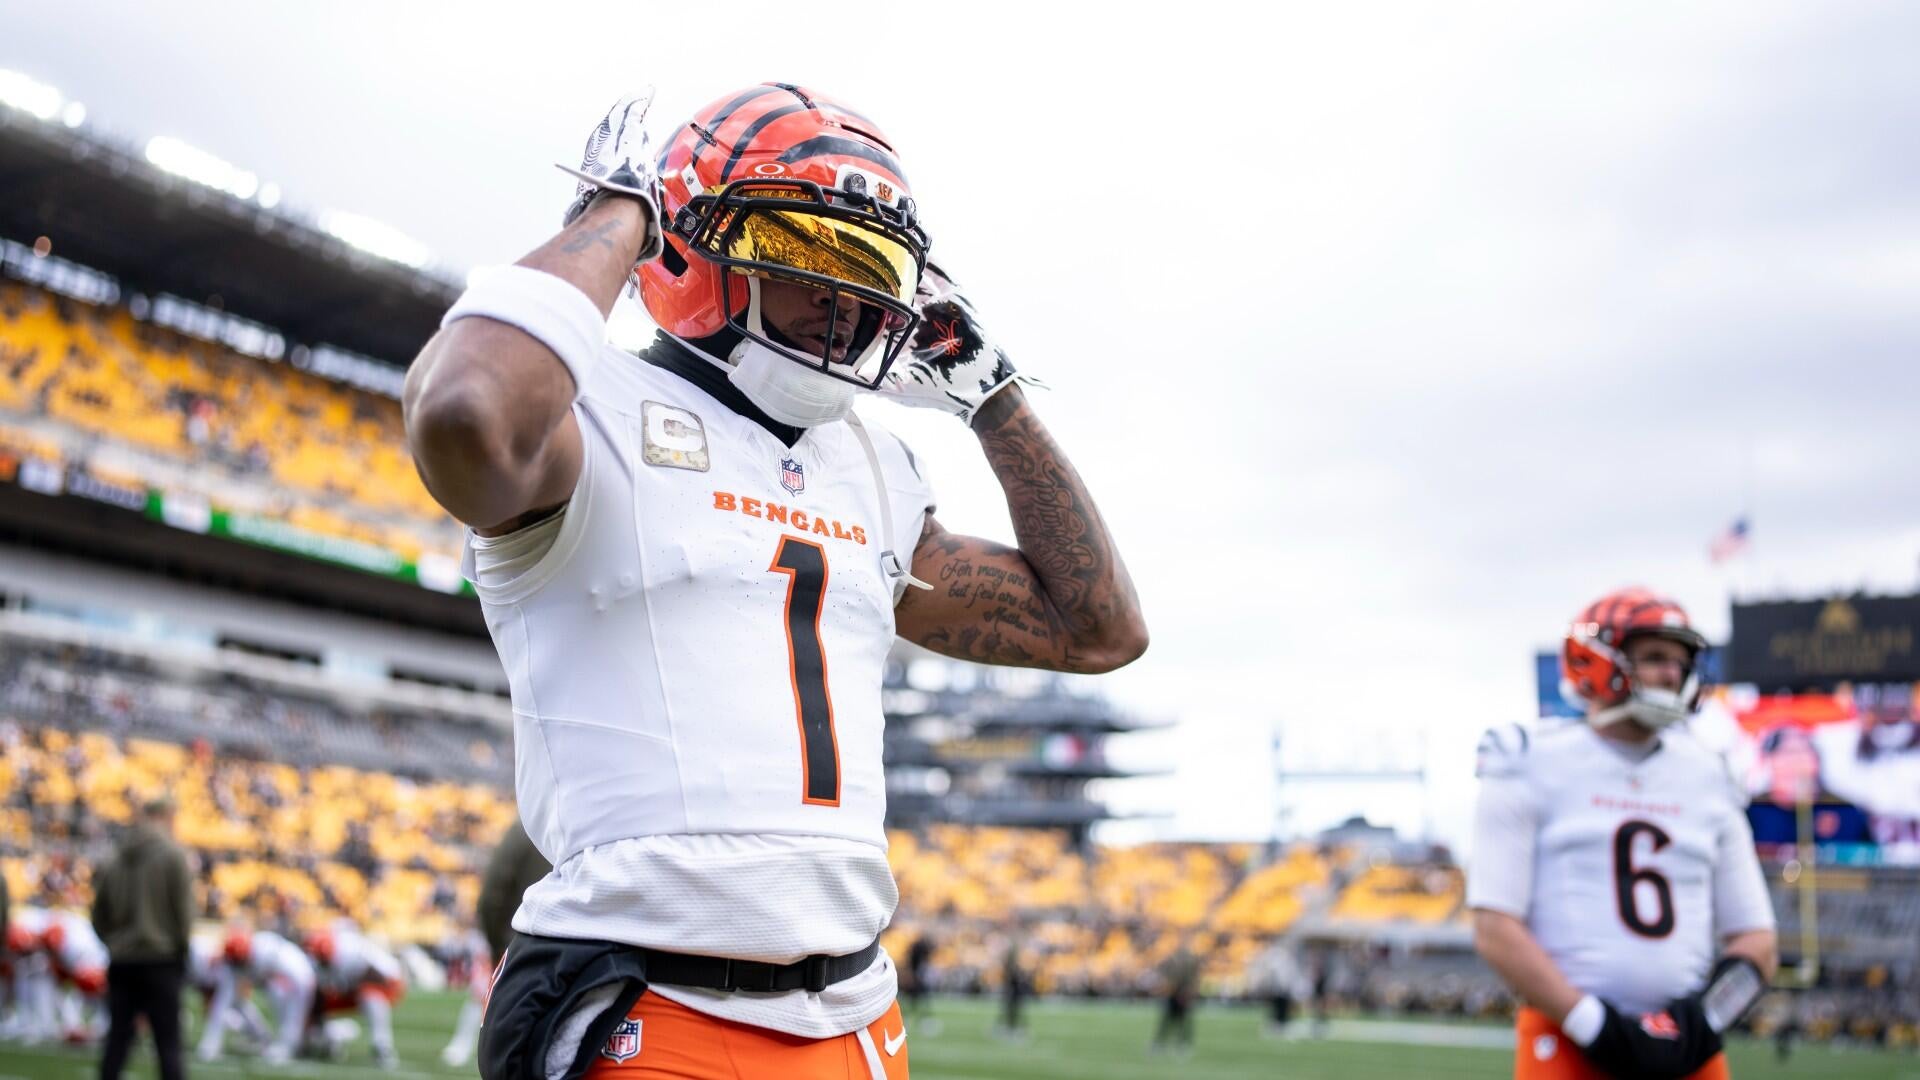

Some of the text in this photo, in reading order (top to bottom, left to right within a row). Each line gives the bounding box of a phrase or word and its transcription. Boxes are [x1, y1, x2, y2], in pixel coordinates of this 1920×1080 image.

[648, 404, 702, 451] C
[783, 470, 803, 489] NFL
[713, 491, 867, 545] BENGALS
[948, 580, 971, 598] but
[768, 533, 841, 808] 1
[1613, 820, 1676, 941] 6
[607, 1036, 634, 1051] NFL
